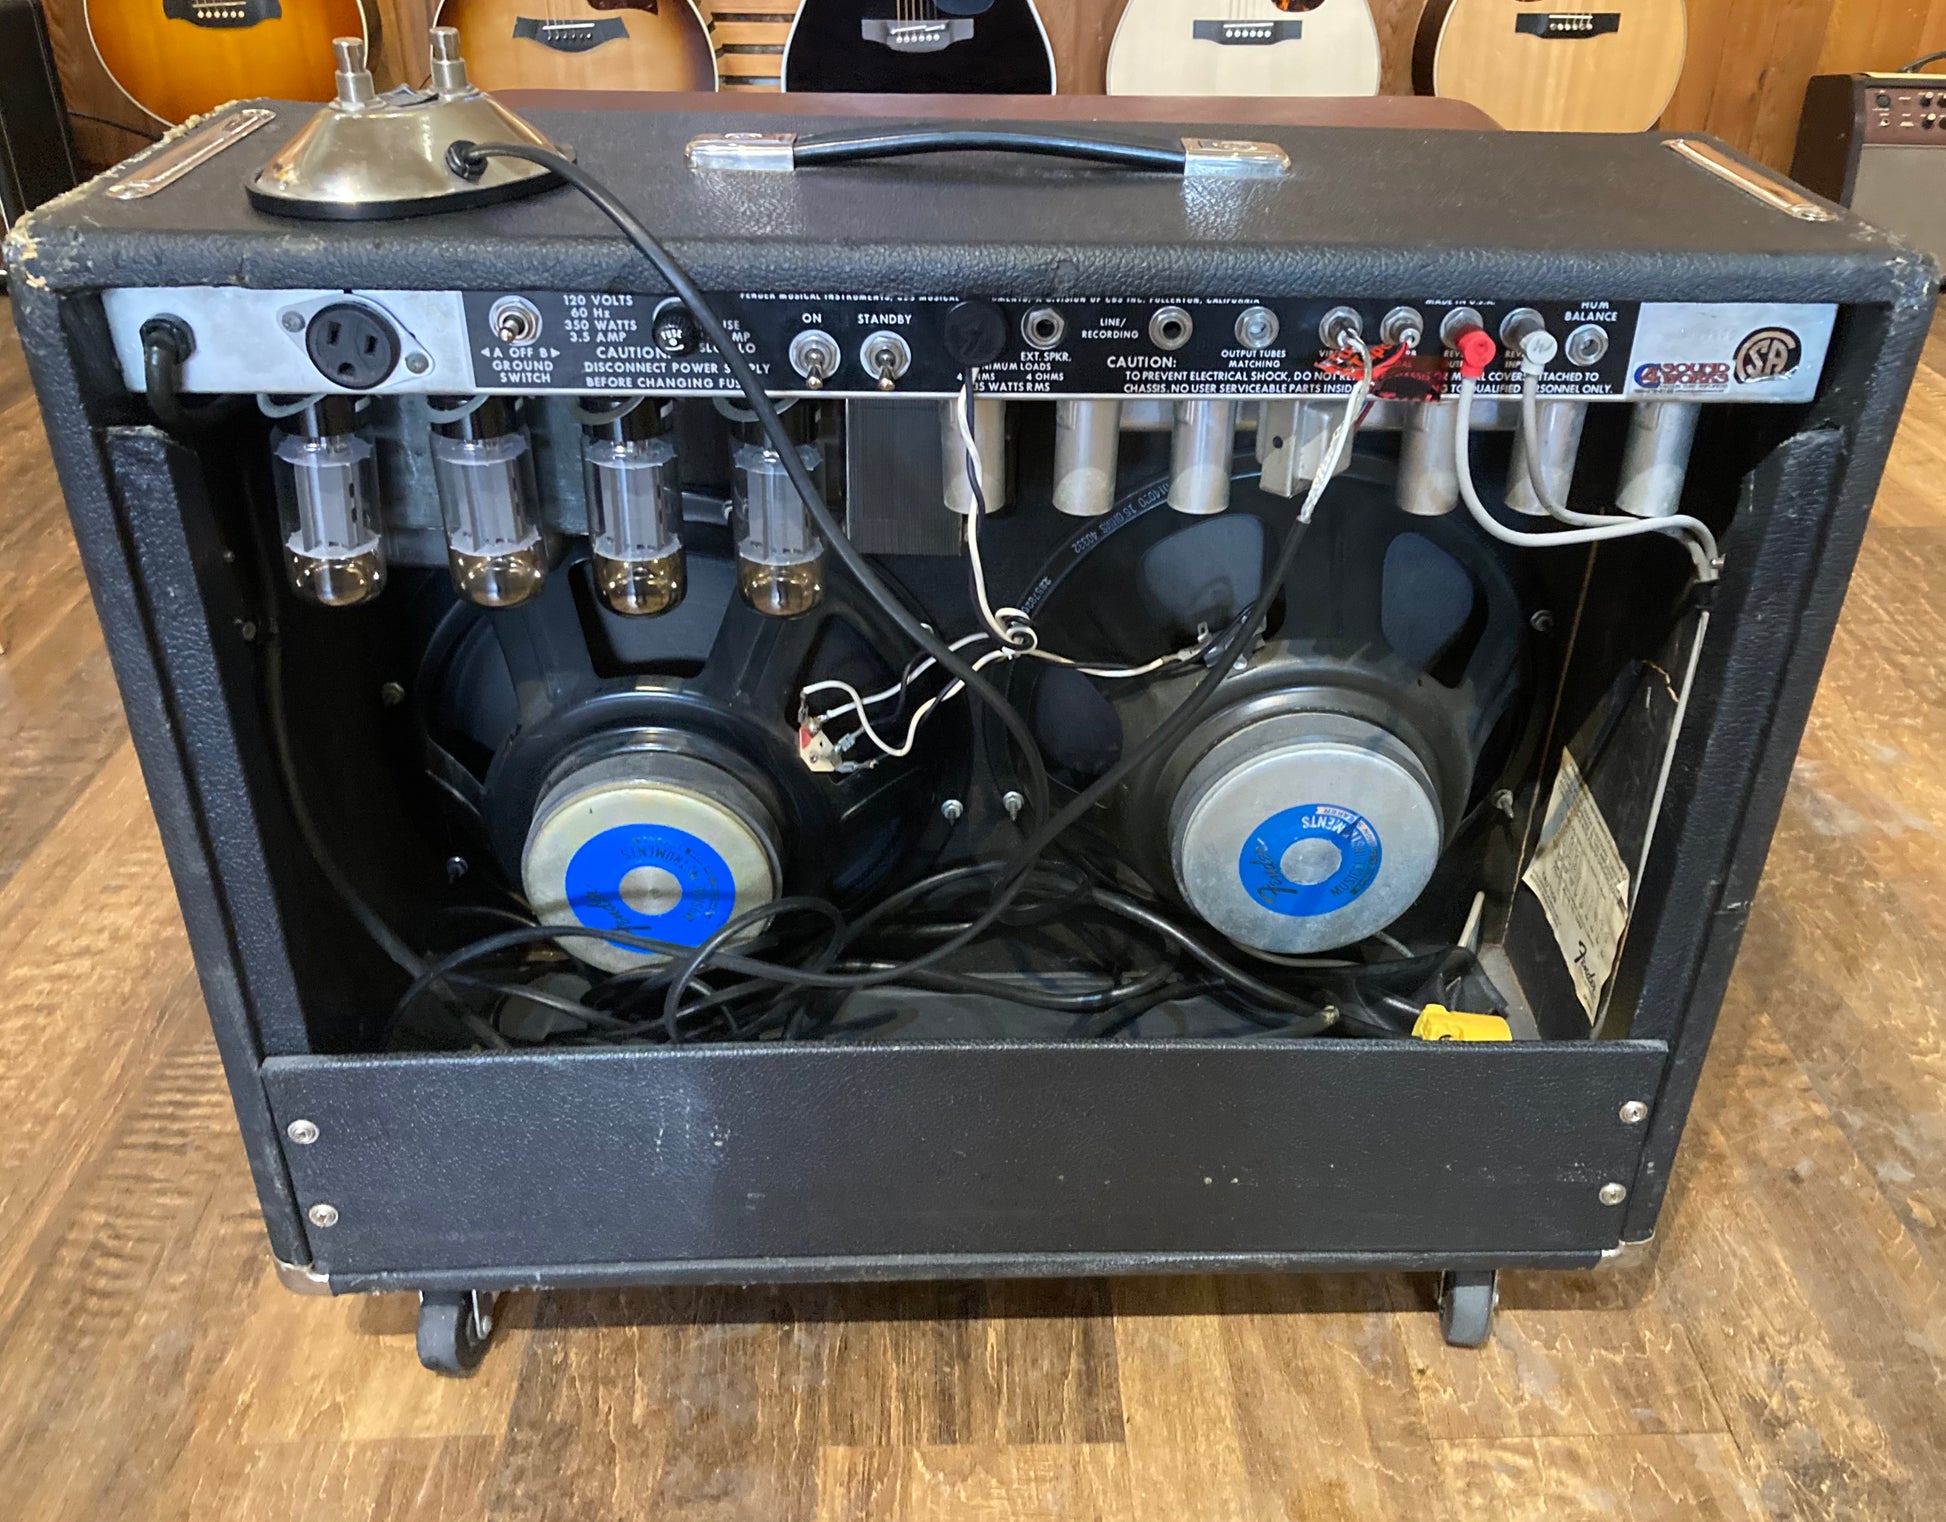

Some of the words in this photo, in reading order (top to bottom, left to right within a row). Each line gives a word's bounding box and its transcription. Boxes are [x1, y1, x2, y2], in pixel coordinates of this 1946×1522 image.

[564, 295, 586, 306] 120
[591, 295, 633, 306] VOLTS
[1580, 301, 1610, 310] HUM
[571, 307, 588, 318] 60
[592, 308, 611, 319] Hz
[801, 313, 822, 324] ON
[1564, 310, 1618, 322] BALANCE
[857, 313, 912, 326] STANDBY
[1099, 318, 1127, 329] LINE/
[564, 320, 589, 332] 350
[595, 320, 637, 332] WATTS
[569, 331, 590, 343] 3.5
[596, 331, 627, 343] AMP
[661, 329, 683, 341] FUSE
[1081, 329, 1139, 340] RECORDING
[492, 347, 503, 359] A
[509, 348, 534, 359] OFF
[540, 348, 549, 359] B
[1020, 351, 1041, 362] EXT.
[1043, 351, 1072, 362] SPKR.
[1221, 349, 1256, 359] OUTPUT
[1259, 350, 1287, 360] TUBES
[493, 360, 554, 372] GROUND
[584, 361, 667, 374] DISCONNECT
[671, 362, 719, 374] POWER
[1020, 362, 1051, 371] LOADS
[1106, 355, 1178, 369] CAUTION:
[1228, 359, 1281, 369] MATCHING
[1661, 362, 1731, 374] SOUND
[500, 372, 551, 384] SWITCH
[1025, 372, 1033, 381] 4
[1035, 372, 1065, 382] OHMS
[1125, 370, 1140, 382] TO
[1142, 370, 1188, 382] PREVENT
[1190, 370, 1248, 382] ELECTRICAL
[1250, 371, 1293, 383] SHOCK,
[1293, 371, 1313, 382] DO
[1538, 372, 1583, 382] TTACHED
[1585, 372, 1600, 382] TO
[1661, 372, 1730, 385] WORKS
[586, 377, 634, 389] BEFORE
[637, 377, 714, 389] CHANGING
[719, 378, 742, 389] FUS
[988, 381, 1024, 392] WATTS
[1026, 382, 1051, 392] RMS
[1123, 383, 1170, 394] CHASSIS.
[1170, 383, 1189, 394] NO
[1190, 383, 1217, 394] USER
[1218, 383, 1287, 394] SERVICEABLE
[1288, 383, 1322, 394] PARTS
[1322, 383, 1353, 394] INSID
[1474, 384, 1521, 394] UALIFIED
[1582, 384, 1614, 394] ONLY.
[1573, 938, 1598, 993] Fender
